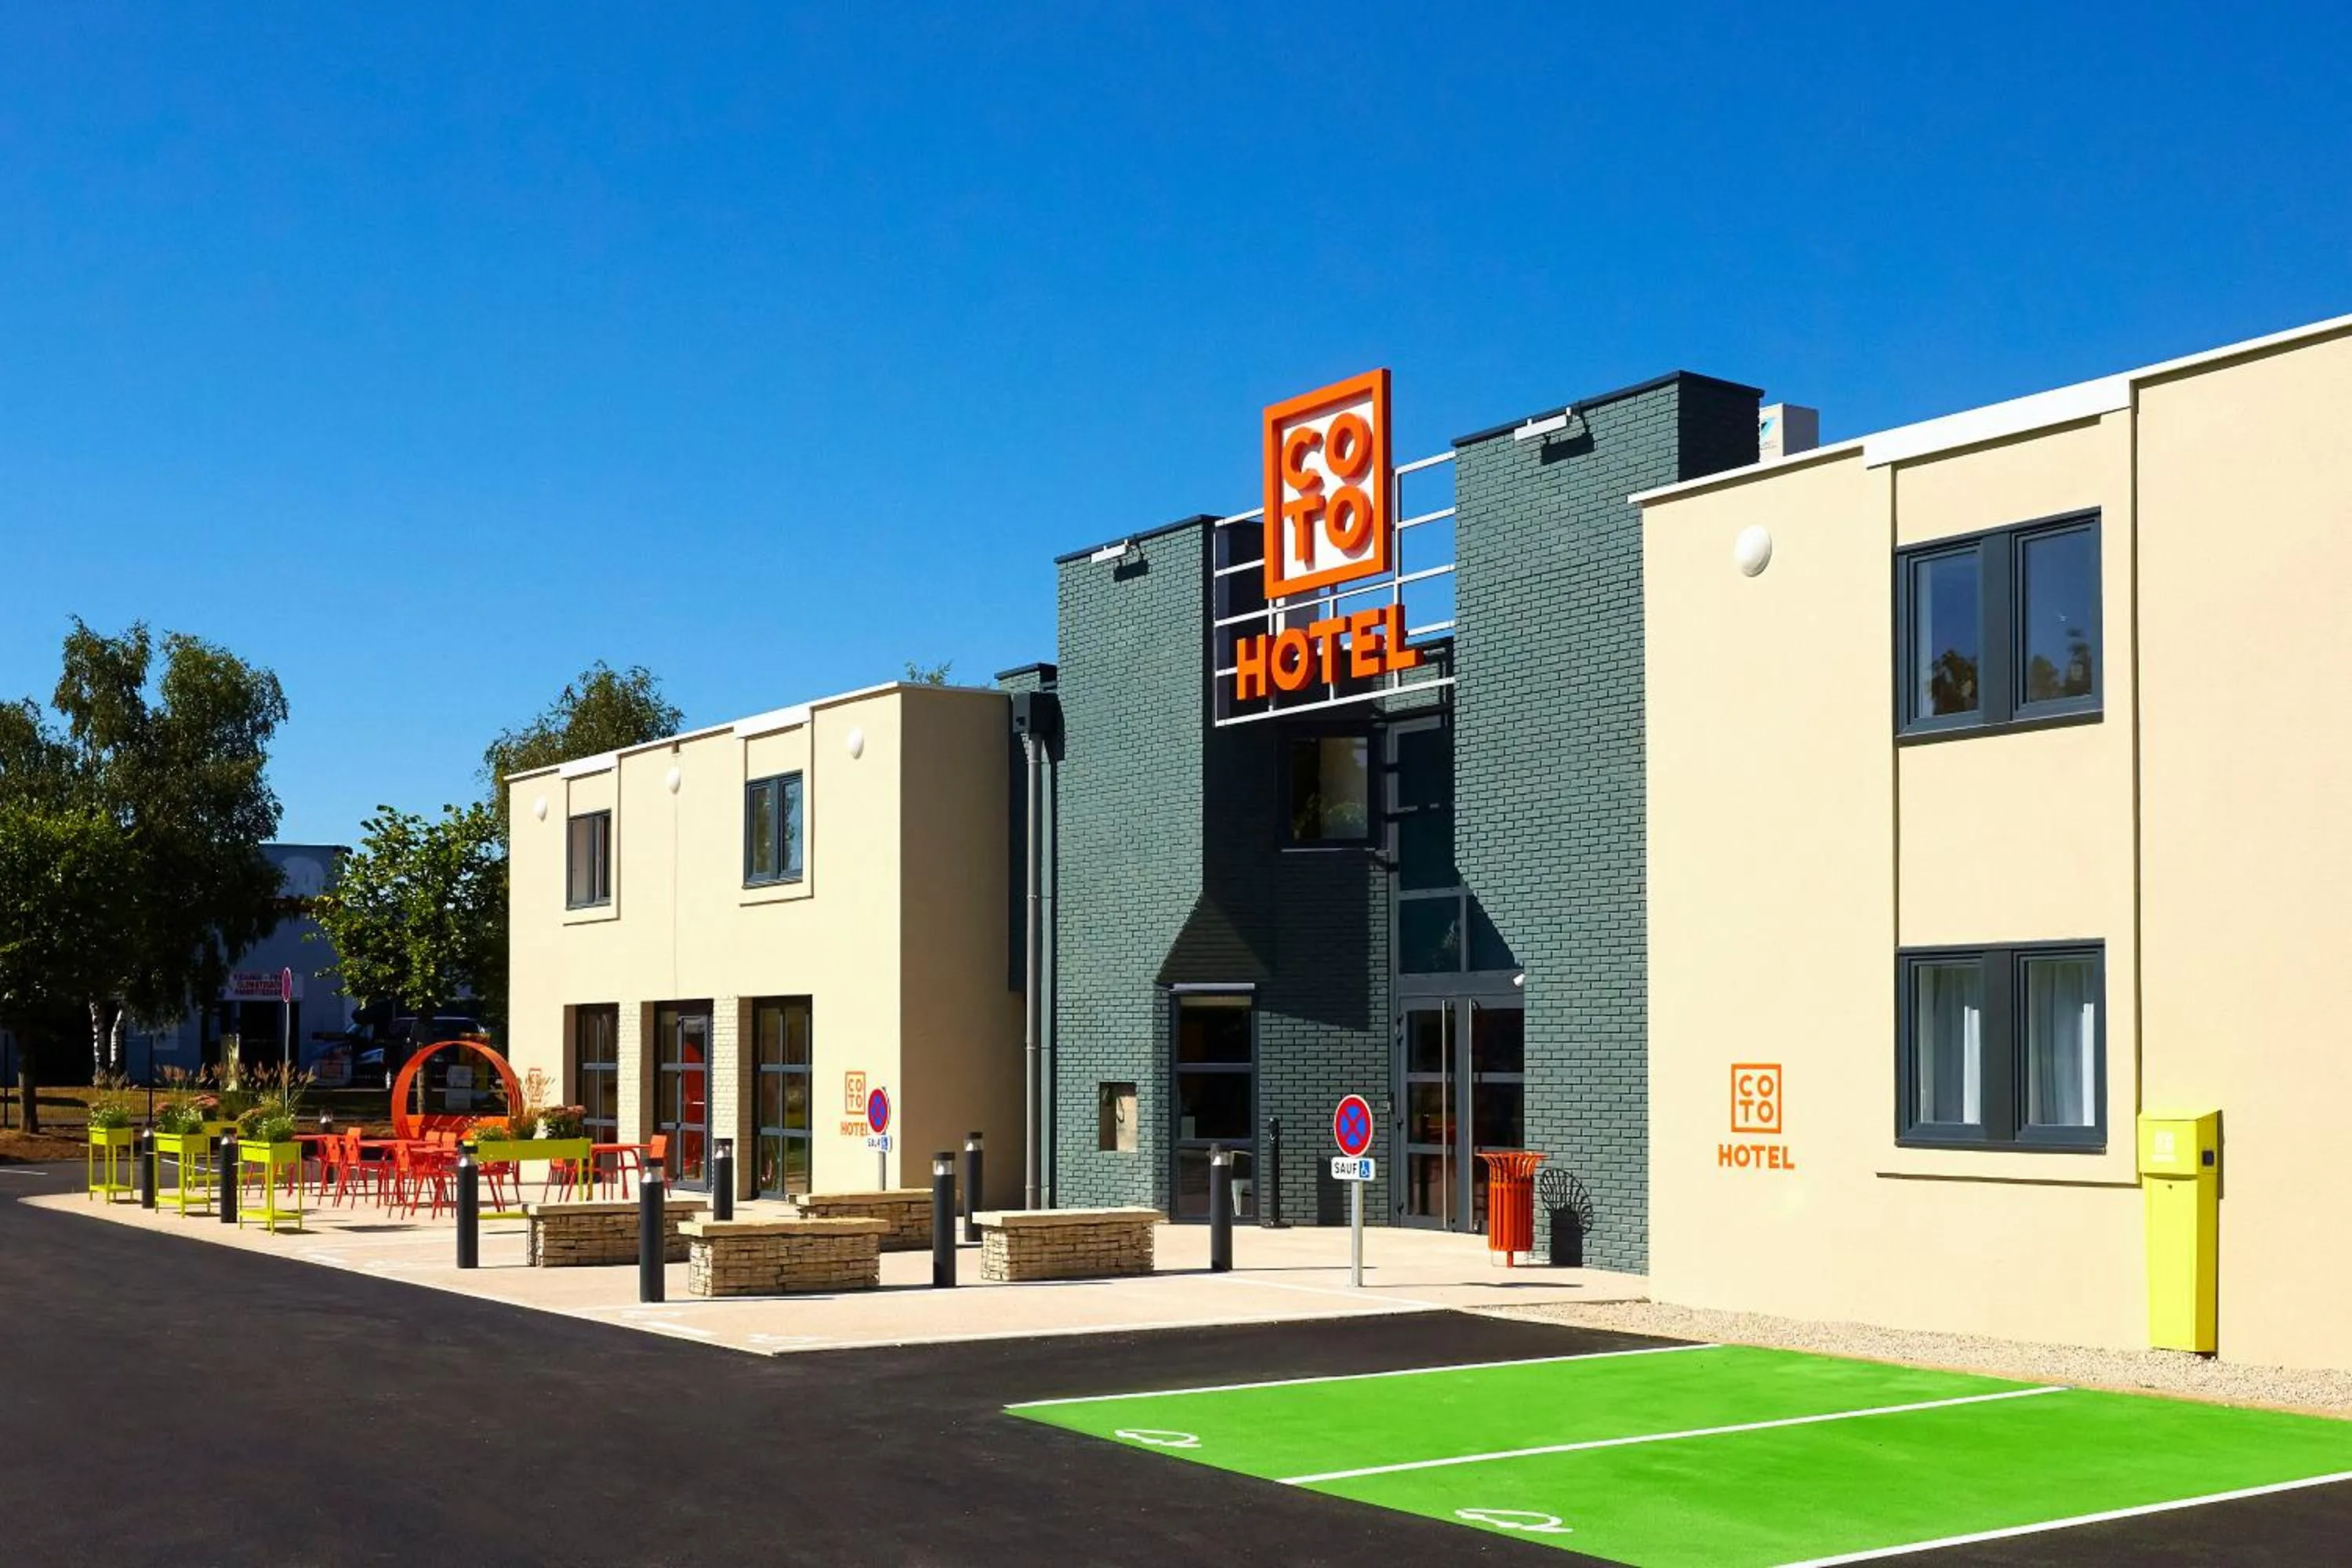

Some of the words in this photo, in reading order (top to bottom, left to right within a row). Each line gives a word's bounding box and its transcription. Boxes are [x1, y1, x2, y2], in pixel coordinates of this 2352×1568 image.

[1281, 412, 1372, 490] CO
[1283, 485, 1372, 562] TO
[1236, 604, 1425, 699] HOTEL
[1739, 1075, 1773, 1098] CO
[1739, 1100, 1773, 1123] TO
[840, 1121, 870, 1136] HOTEL
[1334, 1163, 1357, 1174] SAUF
[1719, 1144, 1795, 1170] HOTEL
